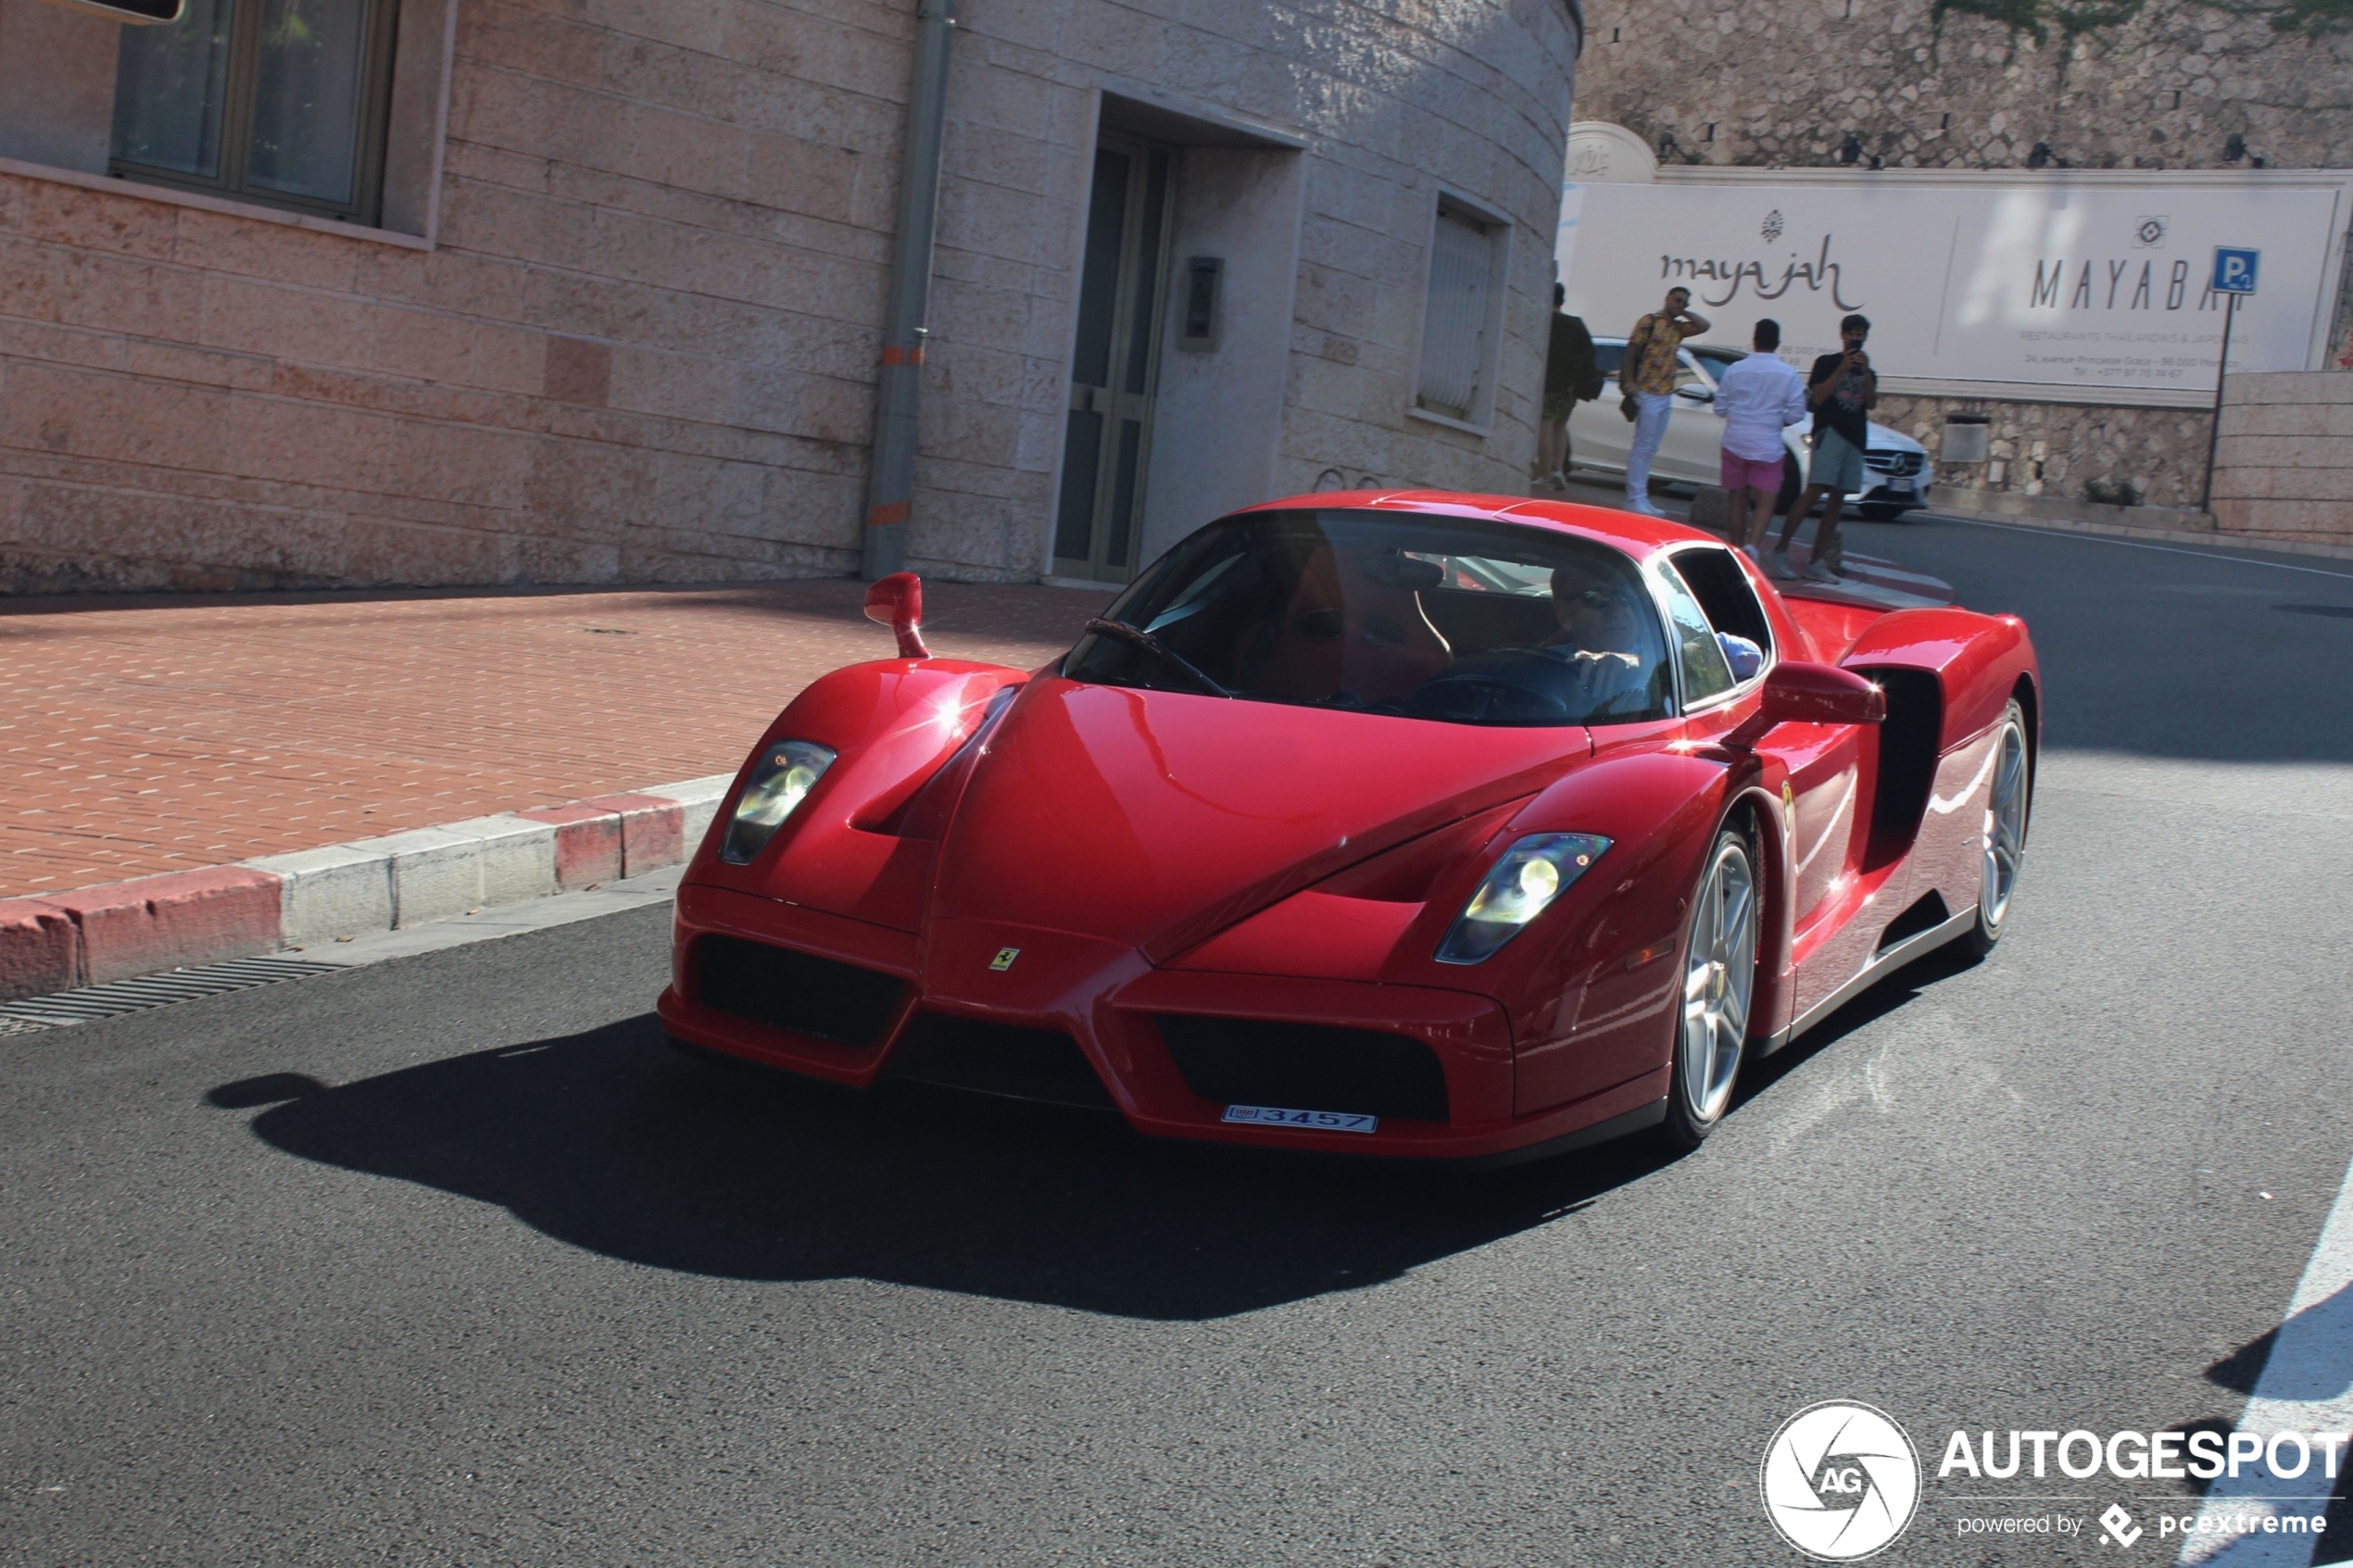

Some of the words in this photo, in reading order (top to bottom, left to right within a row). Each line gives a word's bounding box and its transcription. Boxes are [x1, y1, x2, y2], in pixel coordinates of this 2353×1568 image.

[1661, 254, 1771, 307] maya
[1754, 233, 1867, 312] jah
[2223, 256, 2247, 283] P
[2029, 259, 2242, 311] MAYABA
[2020, 331, 2100, 343] RESTAURANTS
[1263, 1109, 1369, 1128] 3457
